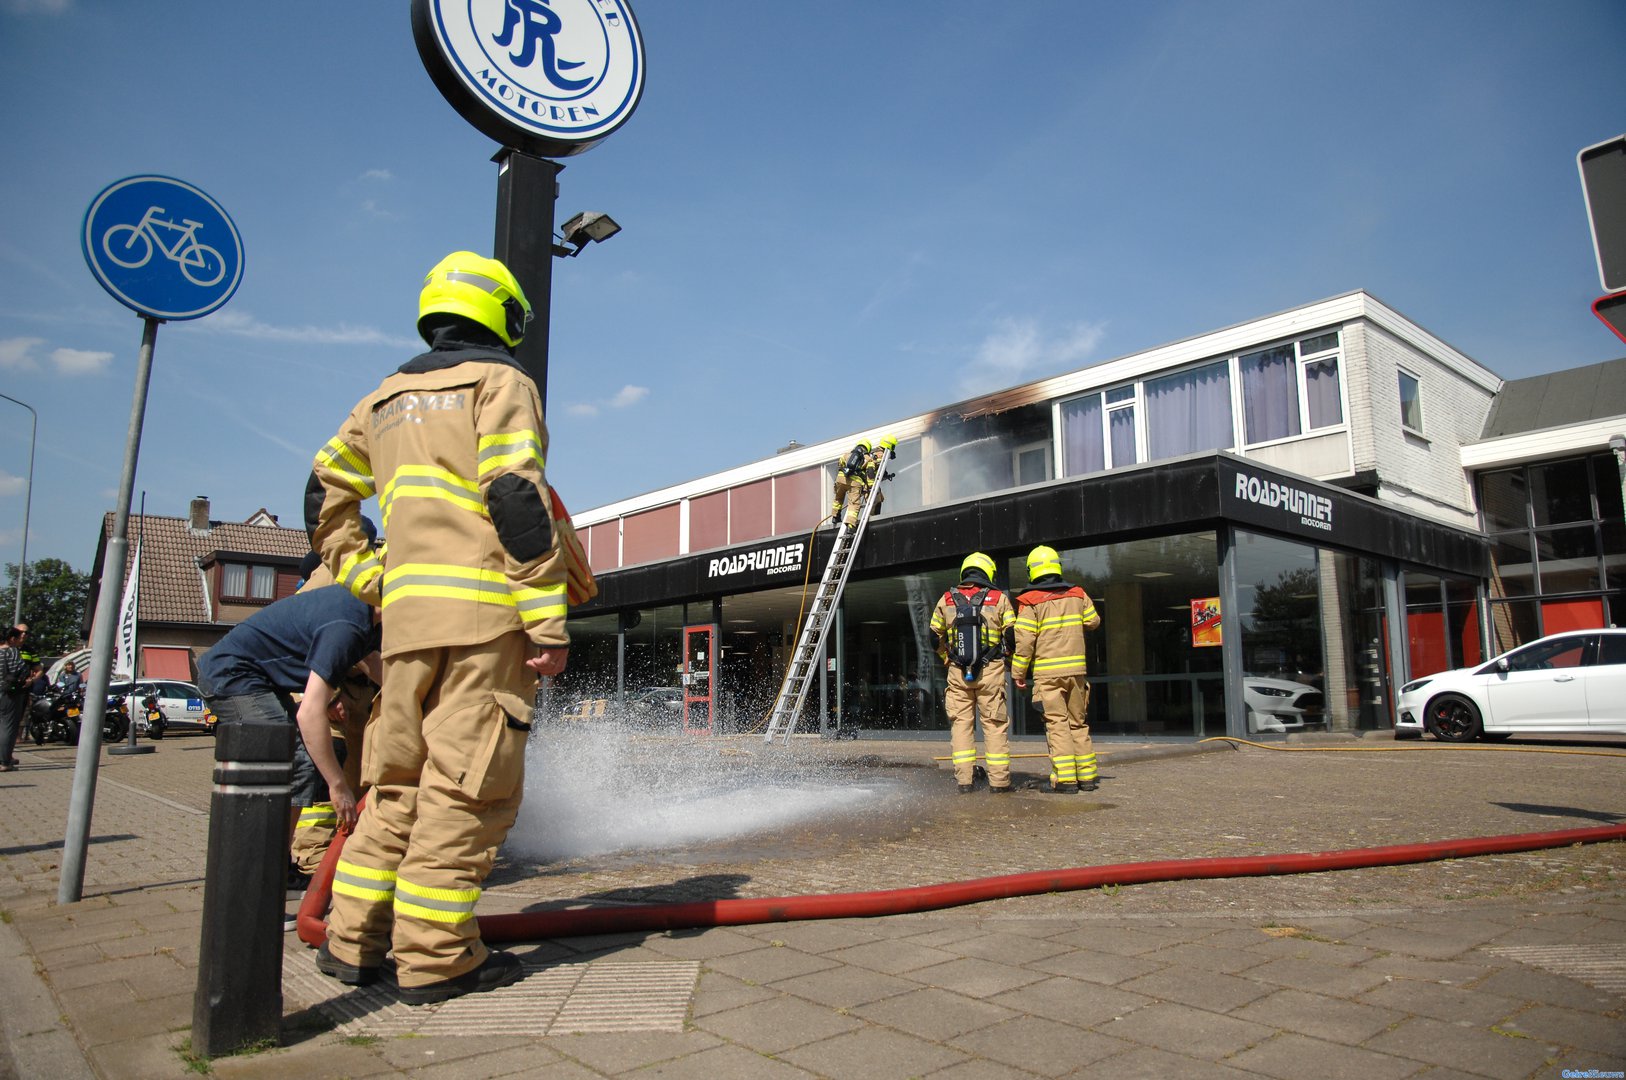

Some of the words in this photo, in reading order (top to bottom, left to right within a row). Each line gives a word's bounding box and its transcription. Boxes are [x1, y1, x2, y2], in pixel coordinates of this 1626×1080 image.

[476, 68, 600, 122] MOTOREN
[1235, 472, 1332, 522] ROADRUNNER
[708, 543, 804, 578] ROADRUNNER
